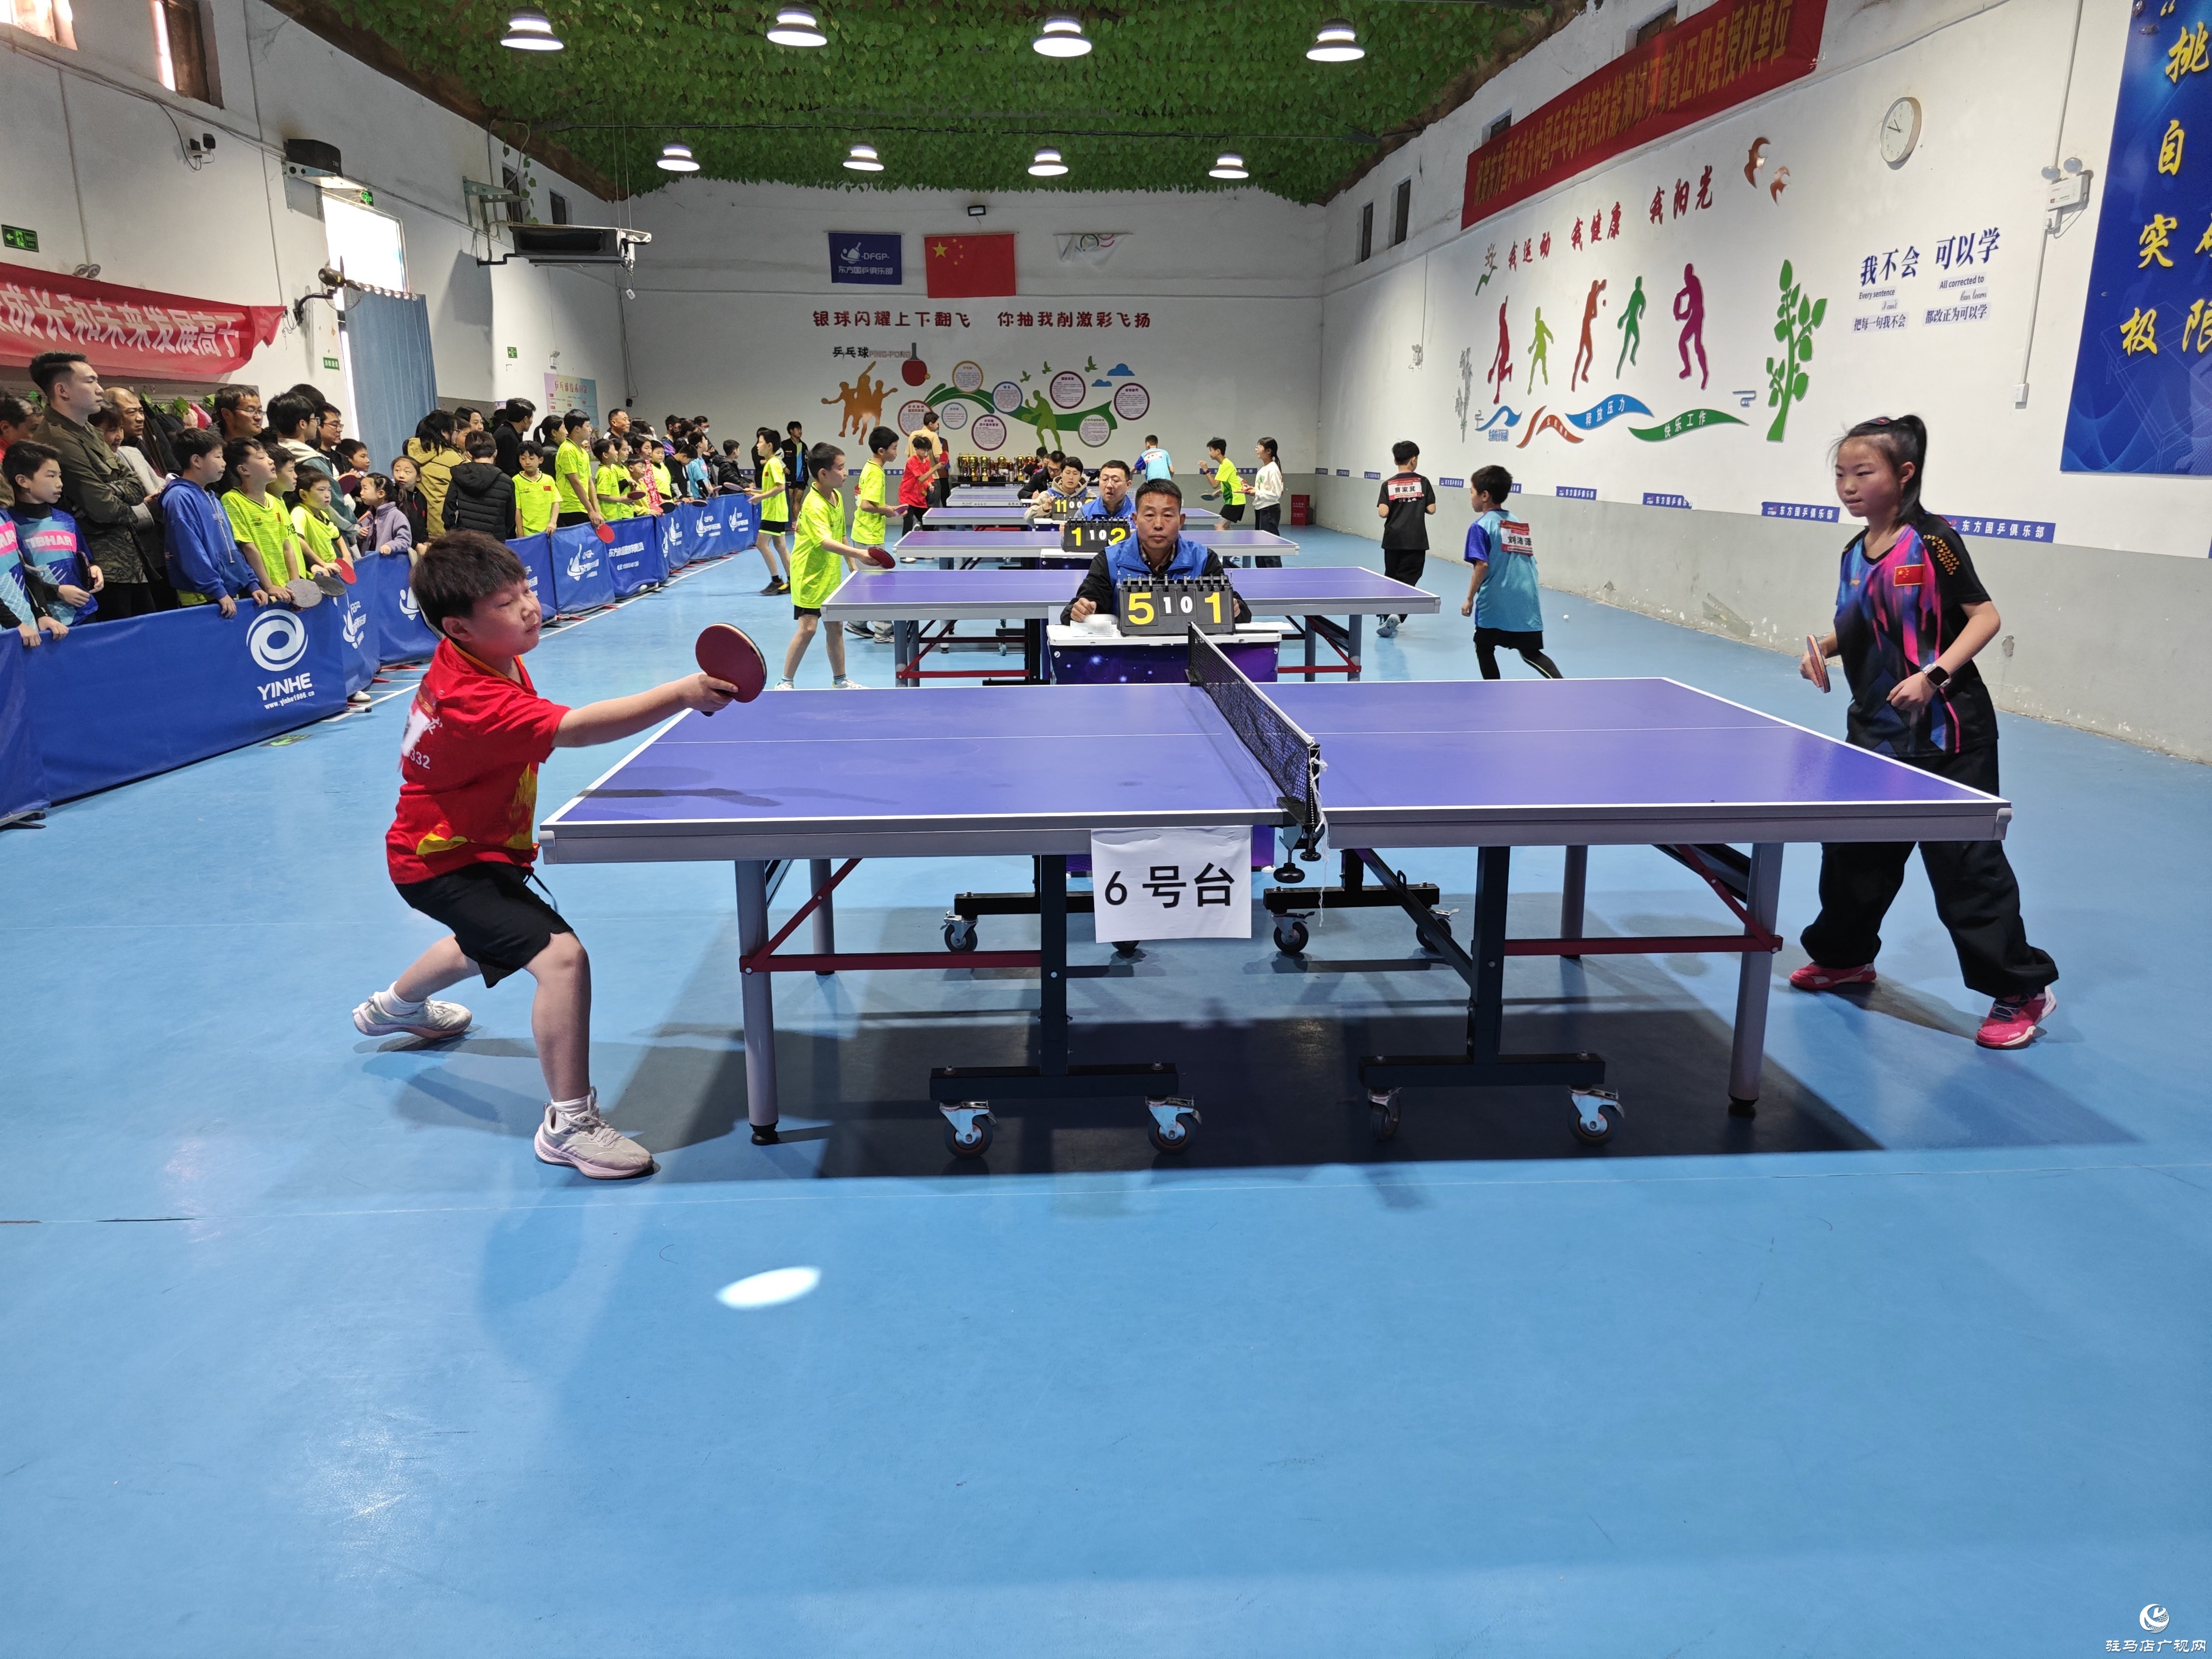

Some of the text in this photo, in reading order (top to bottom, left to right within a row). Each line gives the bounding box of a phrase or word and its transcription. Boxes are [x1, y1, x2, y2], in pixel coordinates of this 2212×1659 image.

[2158, 119, 2185, 176] 自
[1508, 165, 1713, 272] 我运动 我健康 我阳光
[1860, 227, 2001, 287] 我不会 可以学
[838, 266, 893, 275] 东方国乒俱乐部
[1939, 275, 1985, 289] All corrected to
[1859, 289, 1895, 300] Every sentence
[0, 282, 239, 358] 成长和未来发展高于
[813, 311, 1151, 328] 银球闪耀上下翻飞 你抽我削激彩飞扬
[1854, 314, 1906, 332] 把每一句我不会
[1925, 304, 1988, 325] 都改正为可以学
[833, 346, 869, 359] 乒乓球
[1586, 397, 1625, 426] 释放压力
[1664, 410, 1707, 439] 快乐工作
[1779, 505, 1833, 520] 东方国乒俱乐部
[1071, 527, 1126, 546] 1 1 0 2
[1961, 519, 2045, 539] 东方国乒俱乐部
[24, 535, 72, 549] TIBHAR
[1128, 592, 1221, 625] 5 1 0 1
[257, 672, 313, 701] YINHE
[264, 691, 315, 710] www.yinhe1986.cn
